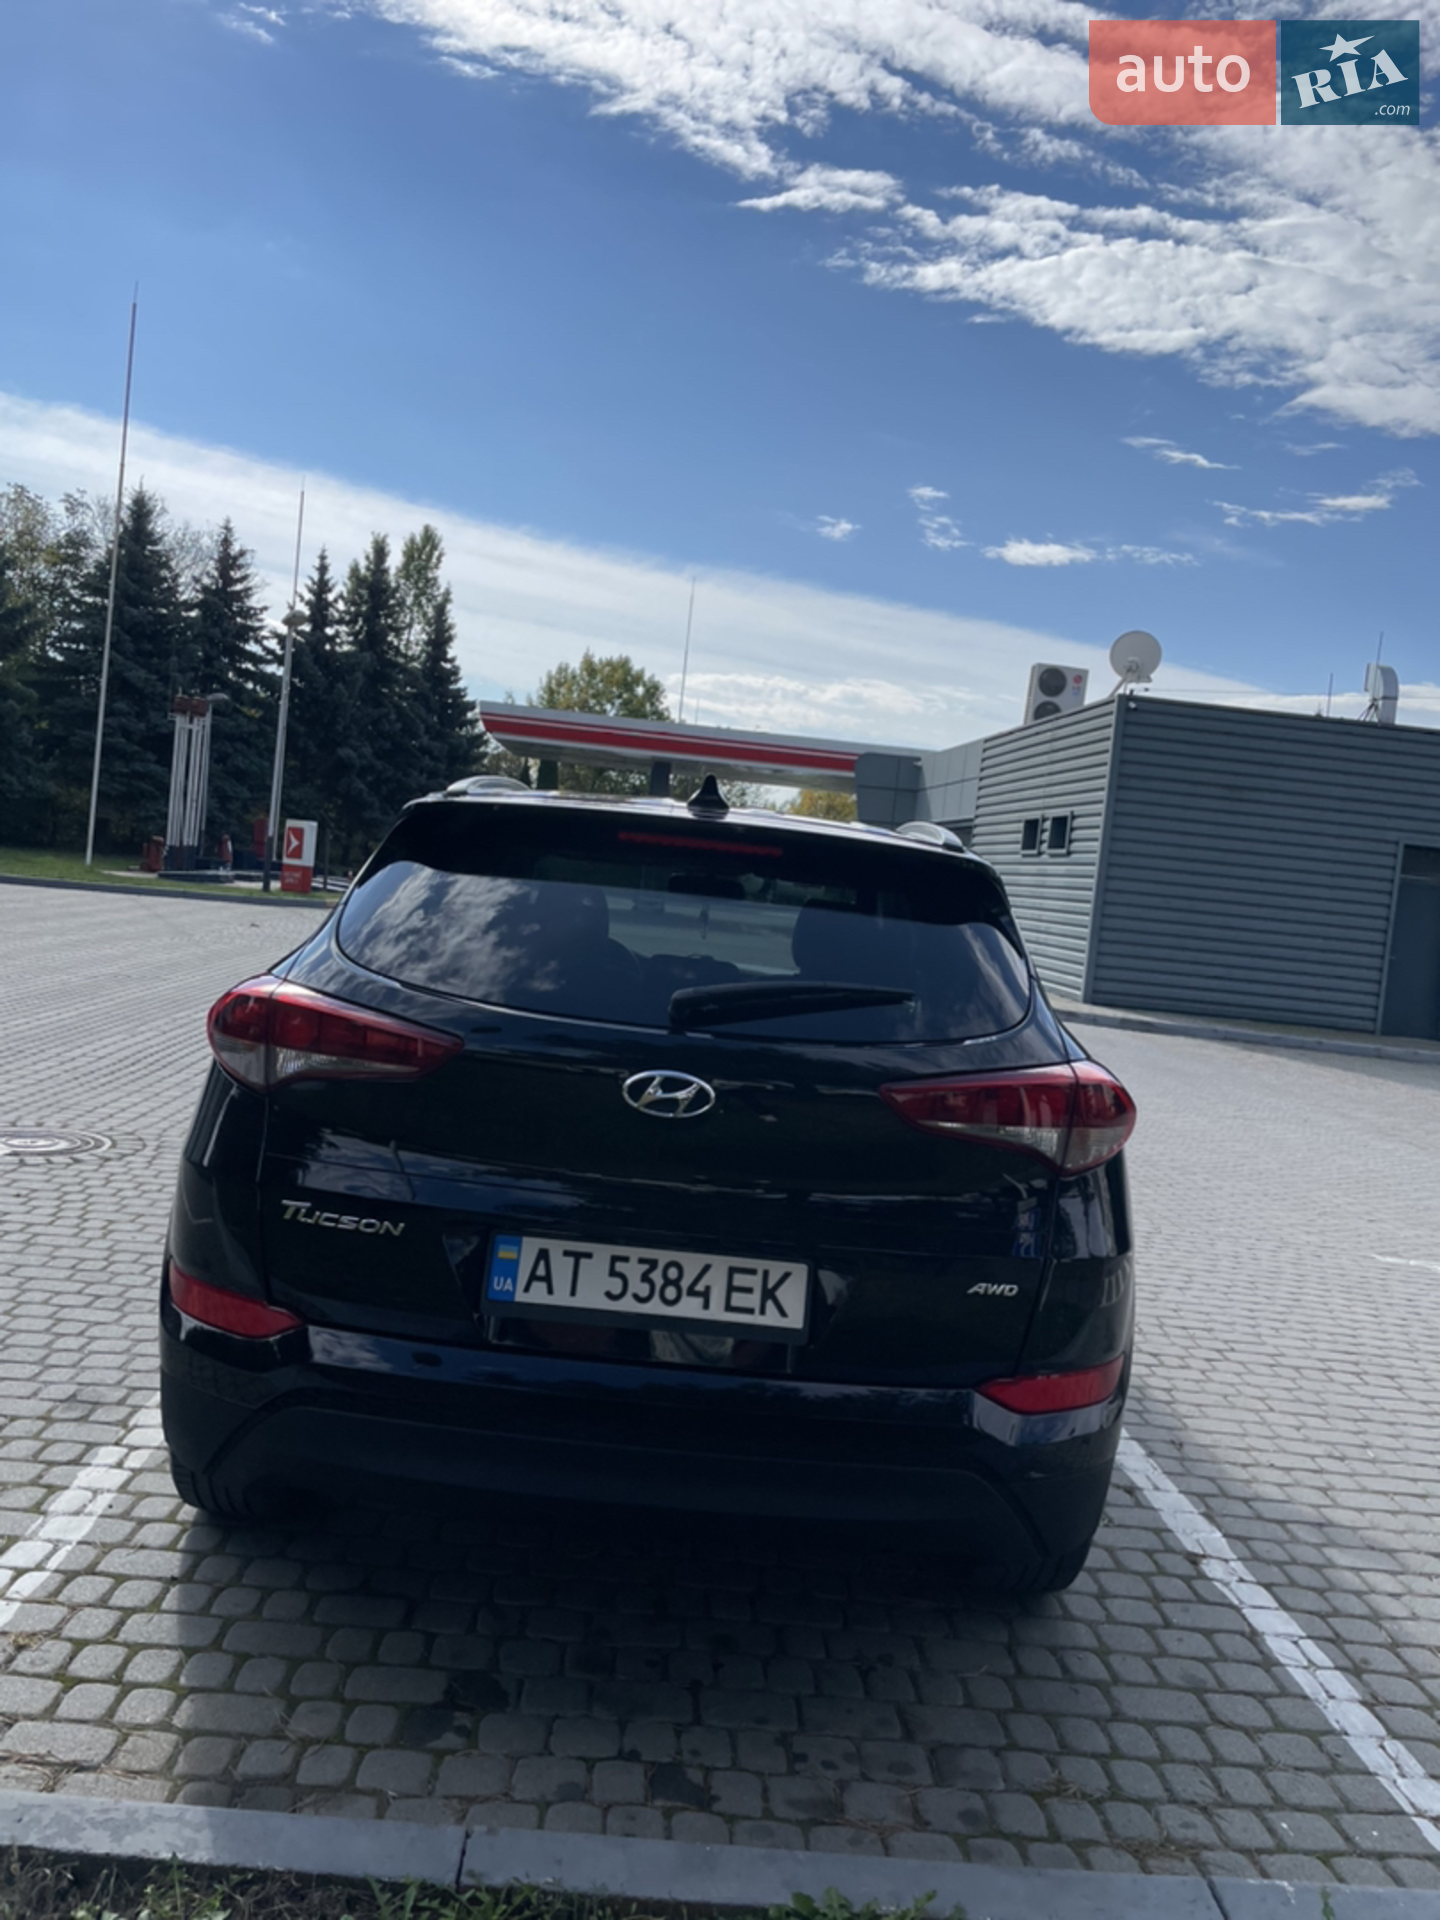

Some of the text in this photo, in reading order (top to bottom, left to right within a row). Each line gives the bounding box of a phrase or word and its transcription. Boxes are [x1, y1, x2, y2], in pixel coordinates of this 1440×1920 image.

[493, 1276, 514, 1292] UA
[522, 1247, 793, 1318] AT 5384 EK
[967, 1282, 1019, 1297] AWD
